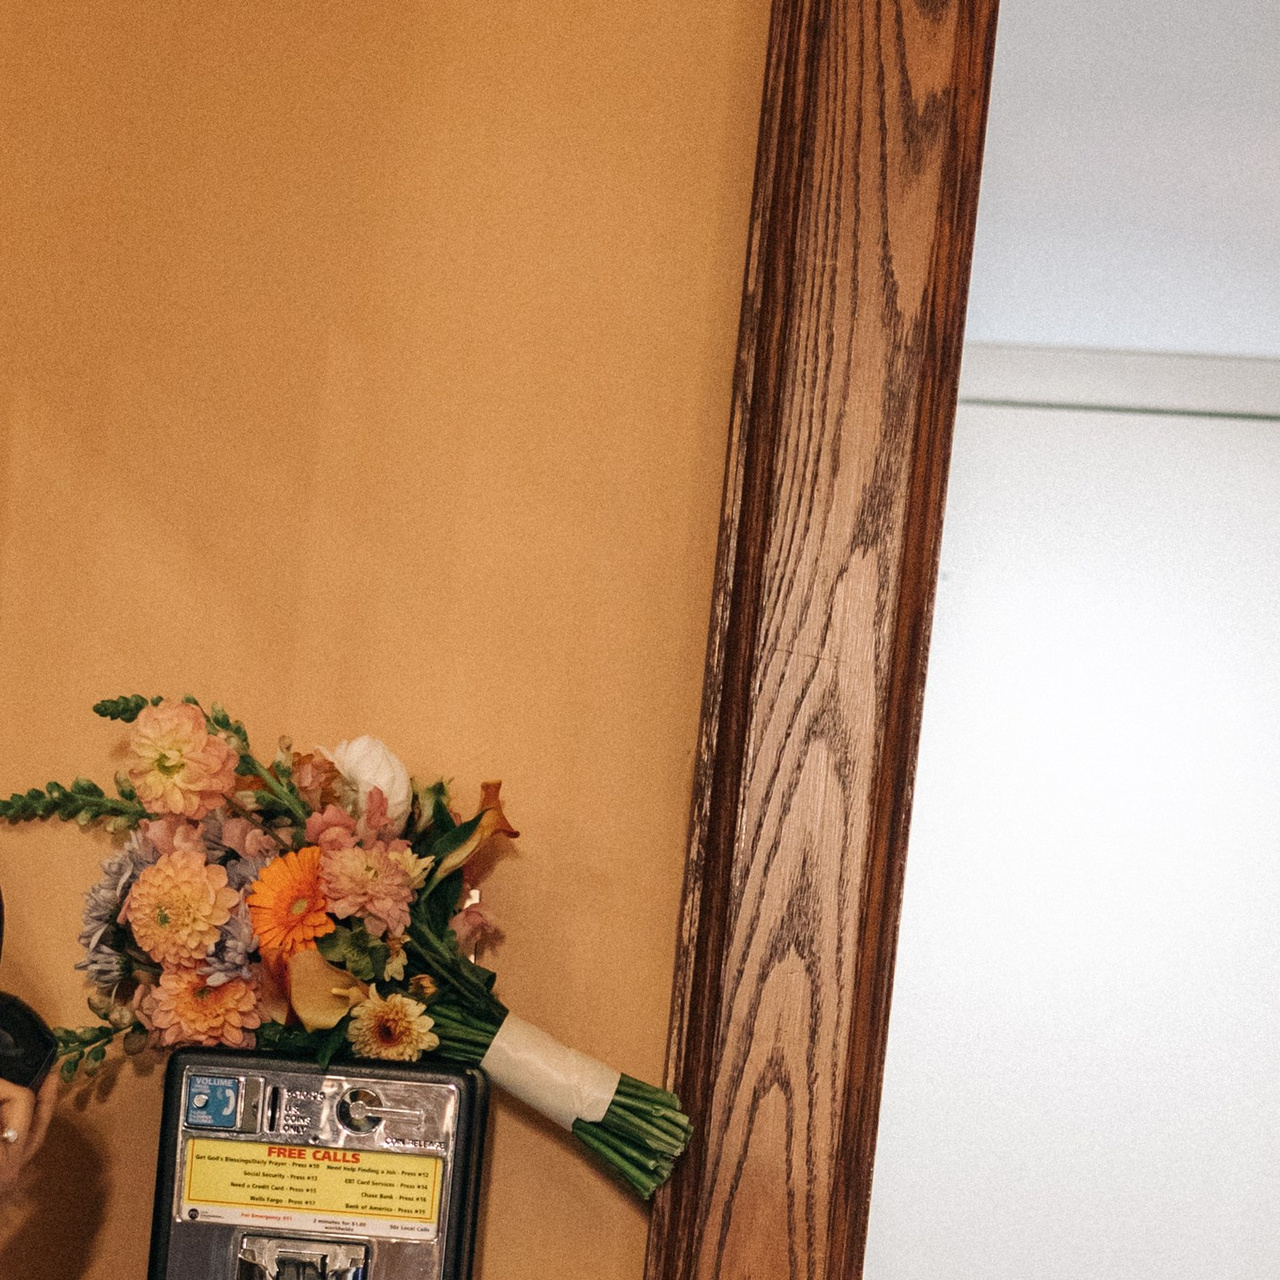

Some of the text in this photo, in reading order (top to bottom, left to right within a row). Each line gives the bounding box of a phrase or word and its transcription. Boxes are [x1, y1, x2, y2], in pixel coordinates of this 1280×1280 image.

[196, 1078, 234, 1087] VOLUME
[267, 1146, 361, 1164] FREE CALLS
[225, 1156, 267, 1166] Blessings/Daily
[358, 1167, 379, 1175] Finding
[252, 1213, 280, 1221] Emergency
